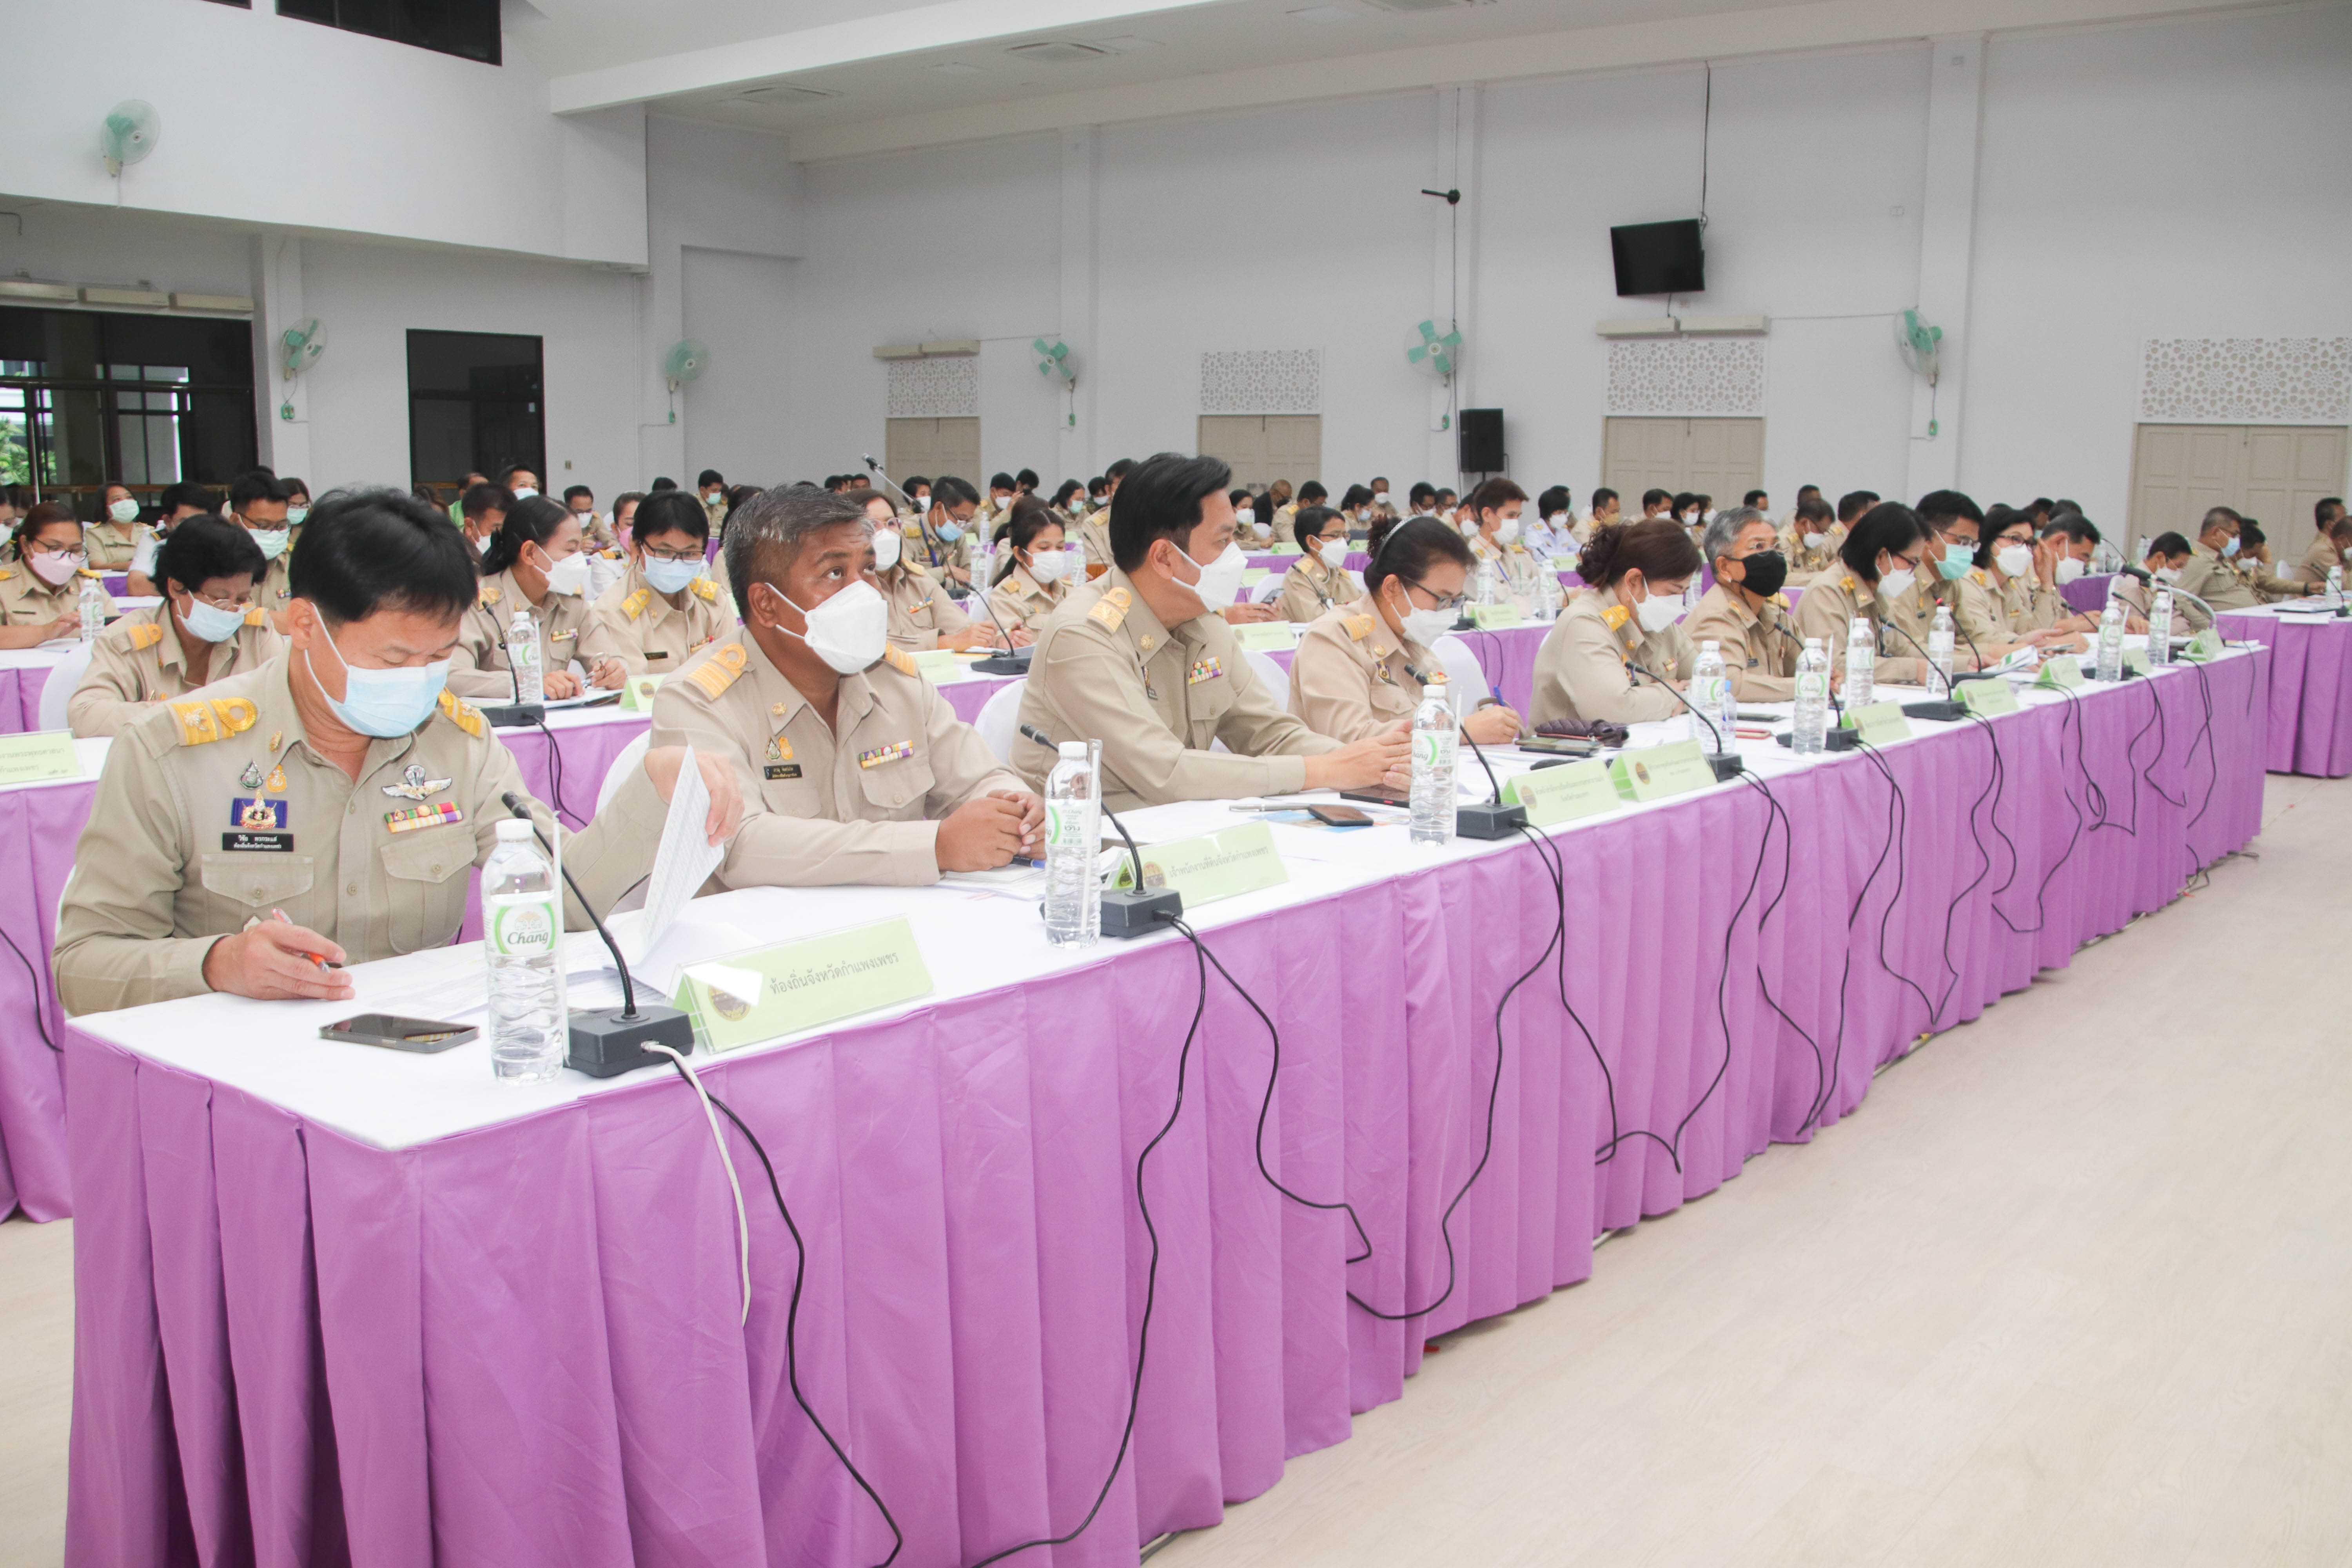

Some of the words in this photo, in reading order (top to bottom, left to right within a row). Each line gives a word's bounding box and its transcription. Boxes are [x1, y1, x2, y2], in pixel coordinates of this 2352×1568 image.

[1412, 750, 1428, 760] hang
[1169, 846, 1269, 878] เจ้าพนักงานที่ดินจังหวัดกำแพงเพชร
[507, 931, 549, 945] Chang
[769, 951, 900, 995] ท้องถิ่นจังหวัดกำแพงเพชร
